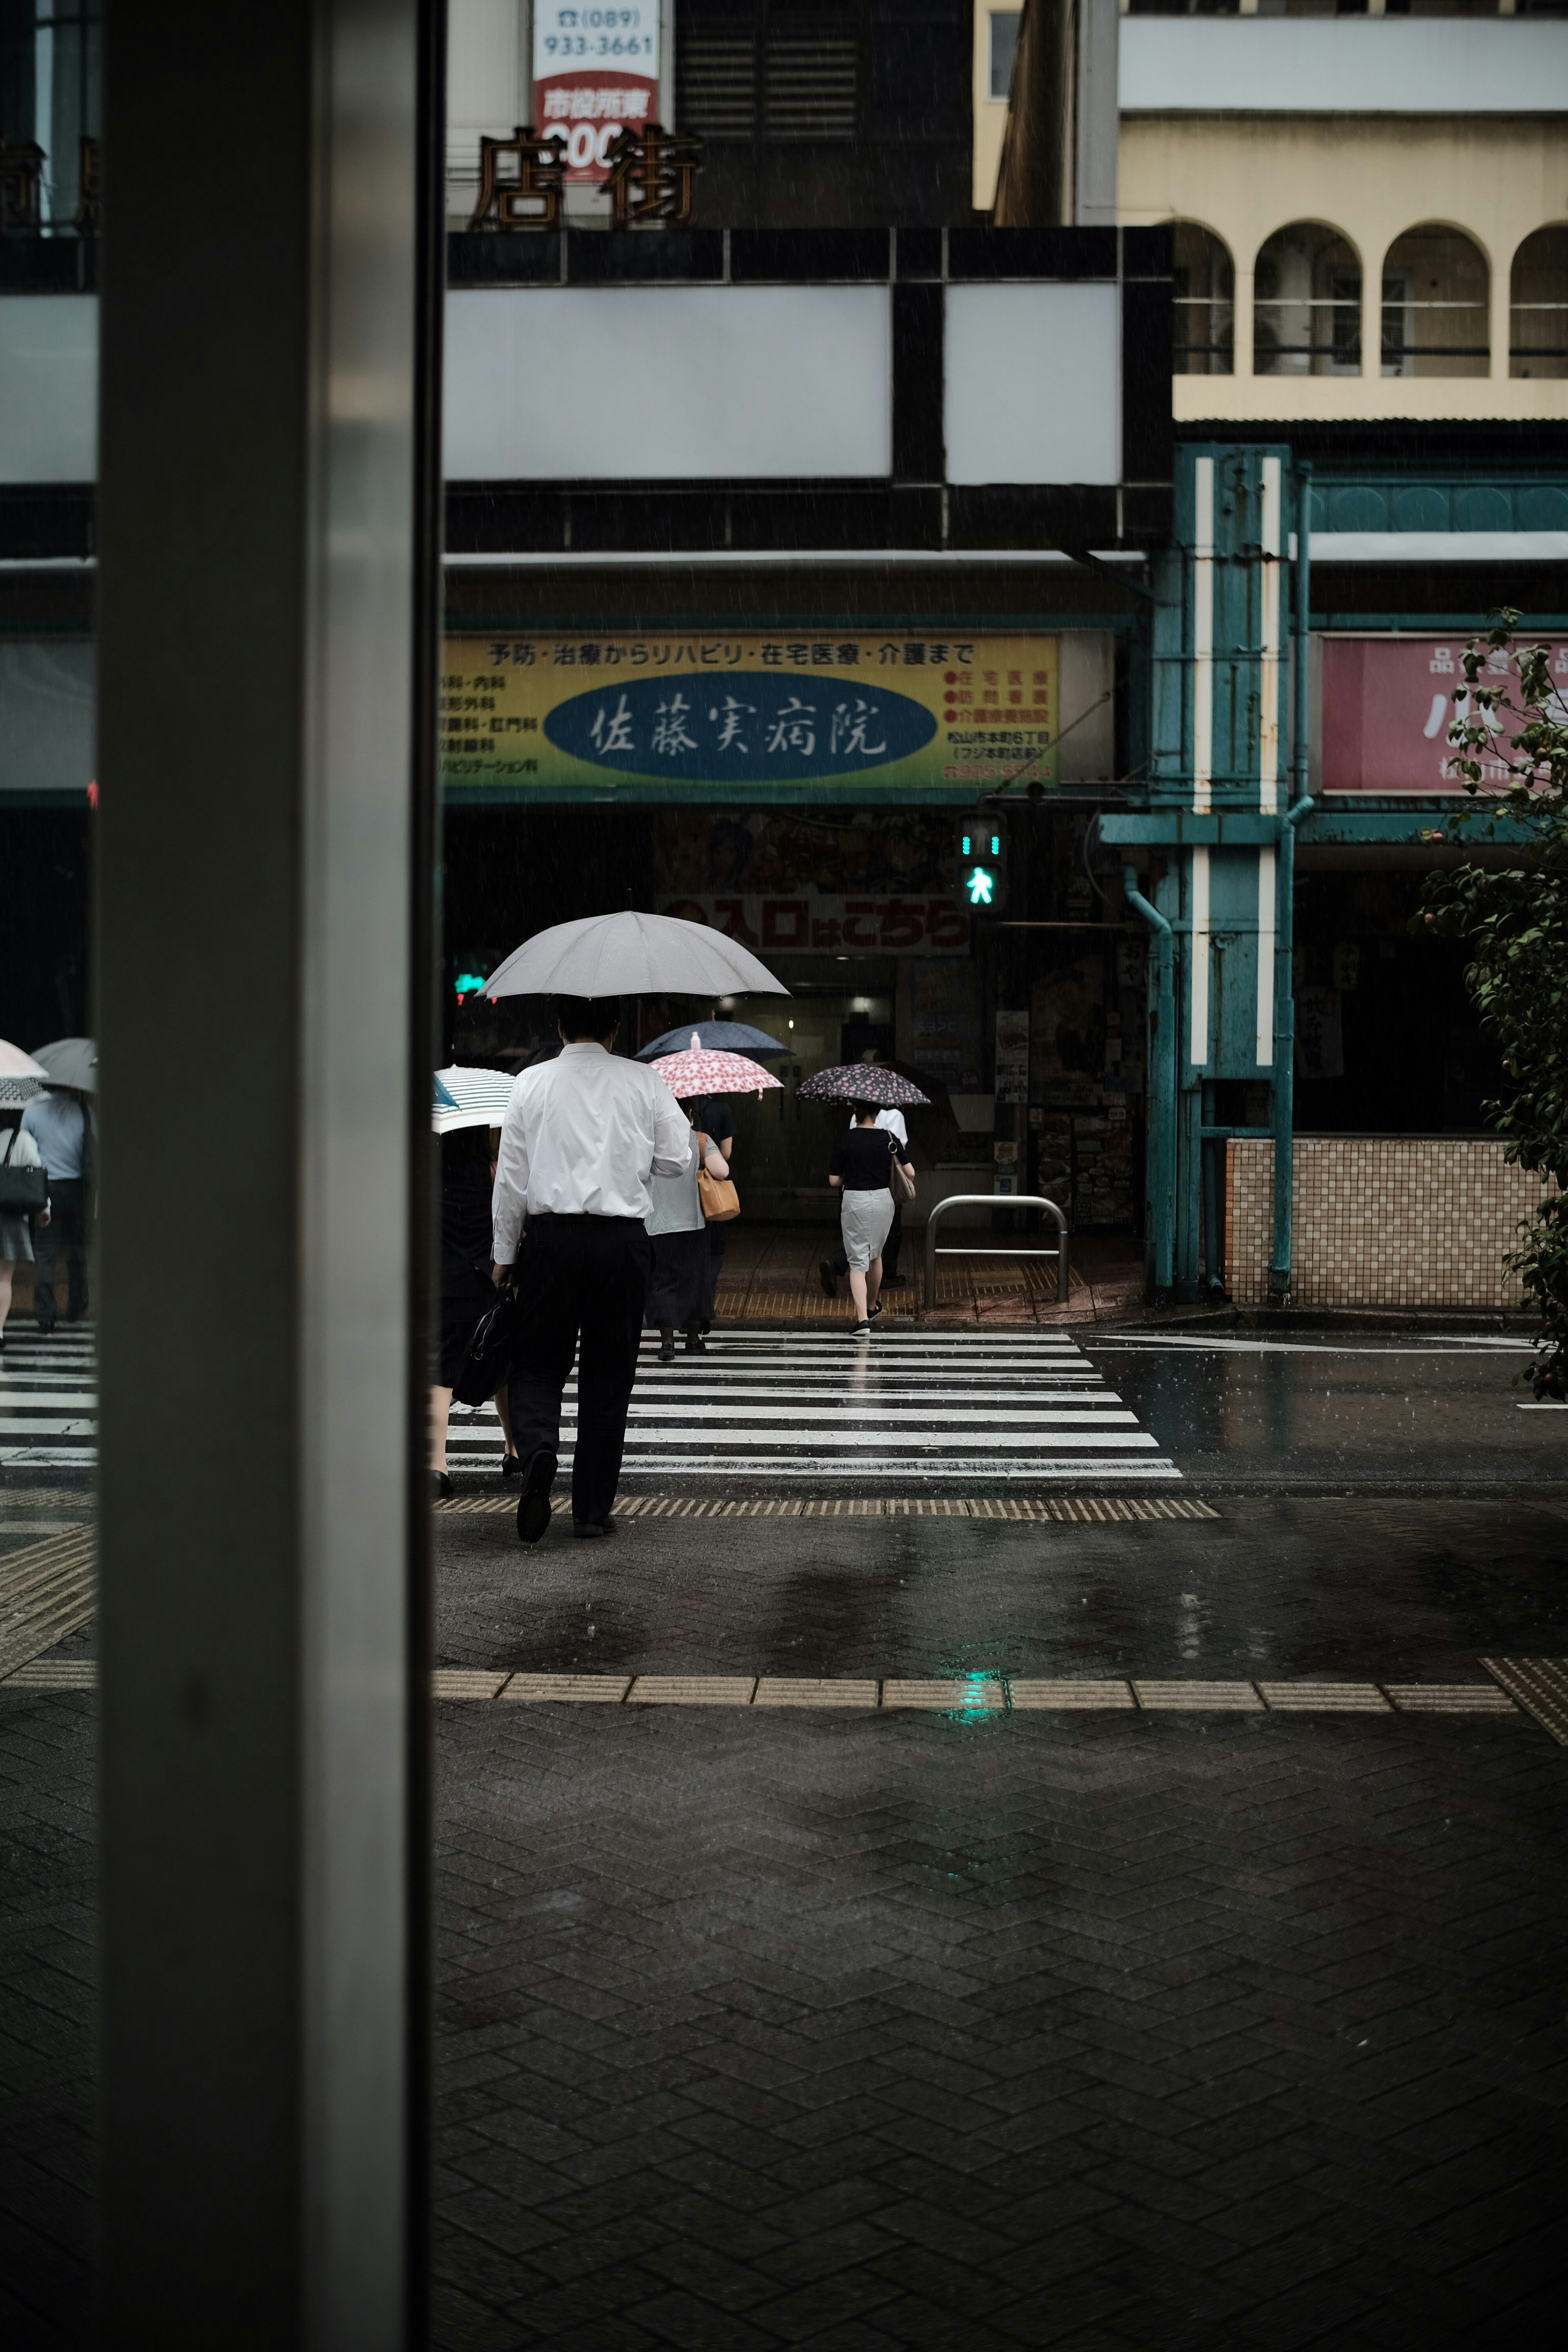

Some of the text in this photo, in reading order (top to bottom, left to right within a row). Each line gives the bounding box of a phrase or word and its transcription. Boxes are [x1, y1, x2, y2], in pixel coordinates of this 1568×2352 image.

[590, 693, 887, 756] 佐藤実病院
